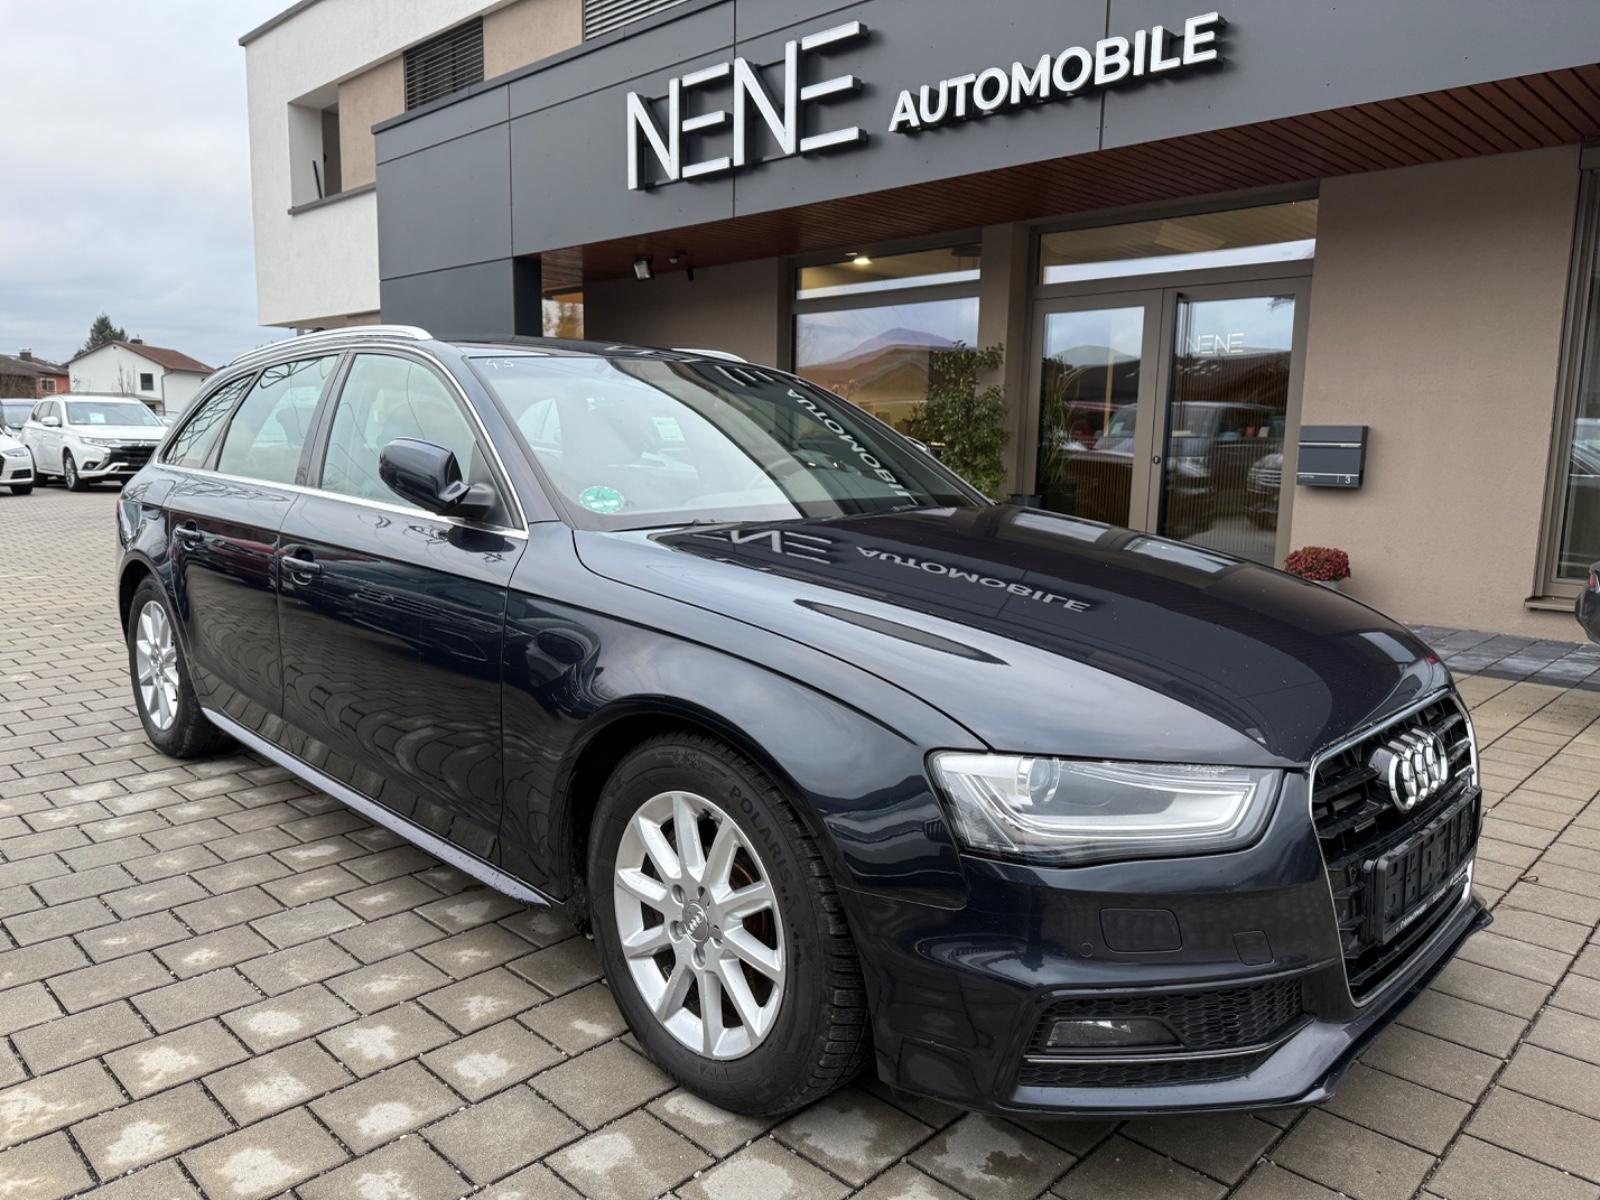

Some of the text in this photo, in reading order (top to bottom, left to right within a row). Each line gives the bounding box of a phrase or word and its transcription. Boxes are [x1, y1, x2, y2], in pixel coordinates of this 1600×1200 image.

[627, 11, 1221, 191] NENE AUTOMOBILE
[729, 785, 794, 882] POLARIS
